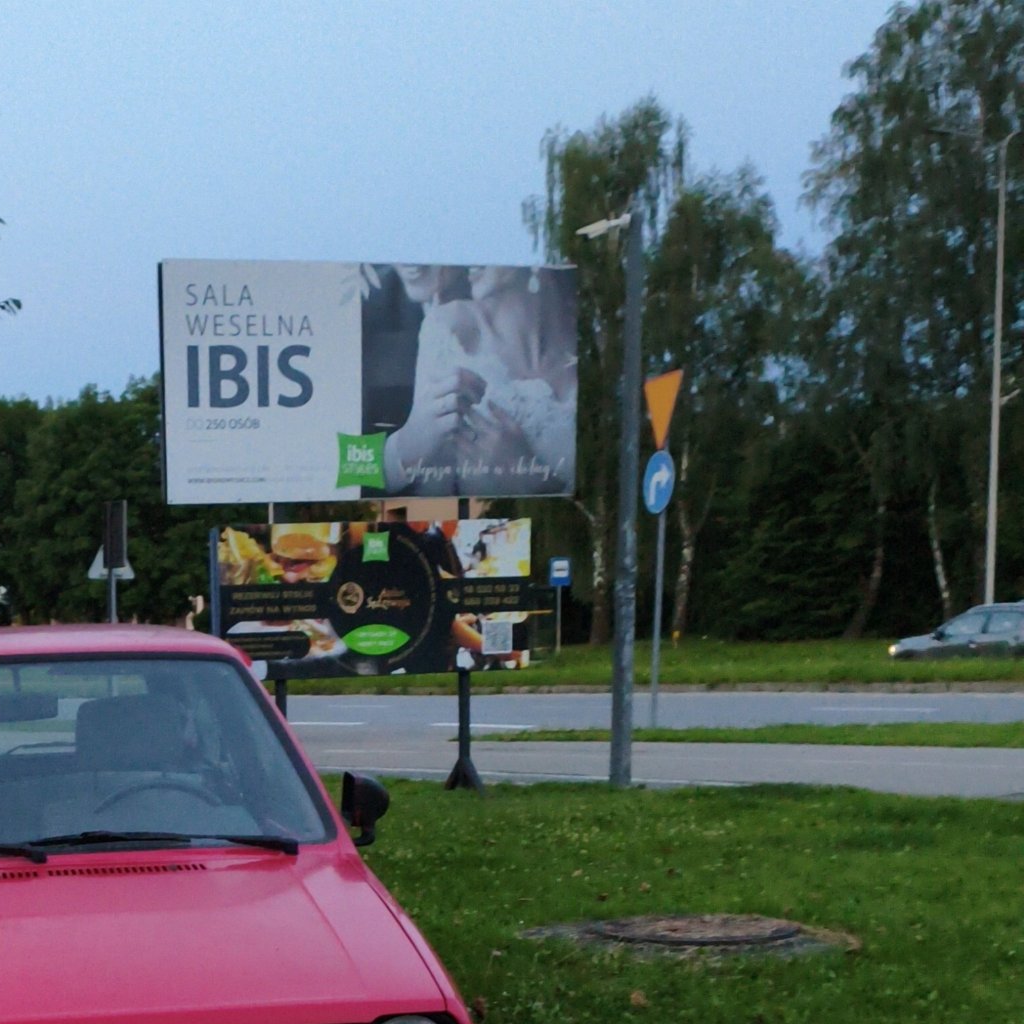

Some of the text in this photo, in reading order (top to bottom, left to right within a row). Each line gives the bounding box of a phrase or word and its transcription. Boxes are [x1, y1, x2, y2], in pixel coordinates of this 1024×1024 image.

[185, 282, 253, 307] SALA
[185, 313, 314, 337] WESELNA
[186, 344, 314, 408] IBIS
[205, 418, 226, 430] 250
[228, 416, 261, 430] OSÓB
[346, 444, 375, 462] ibis
